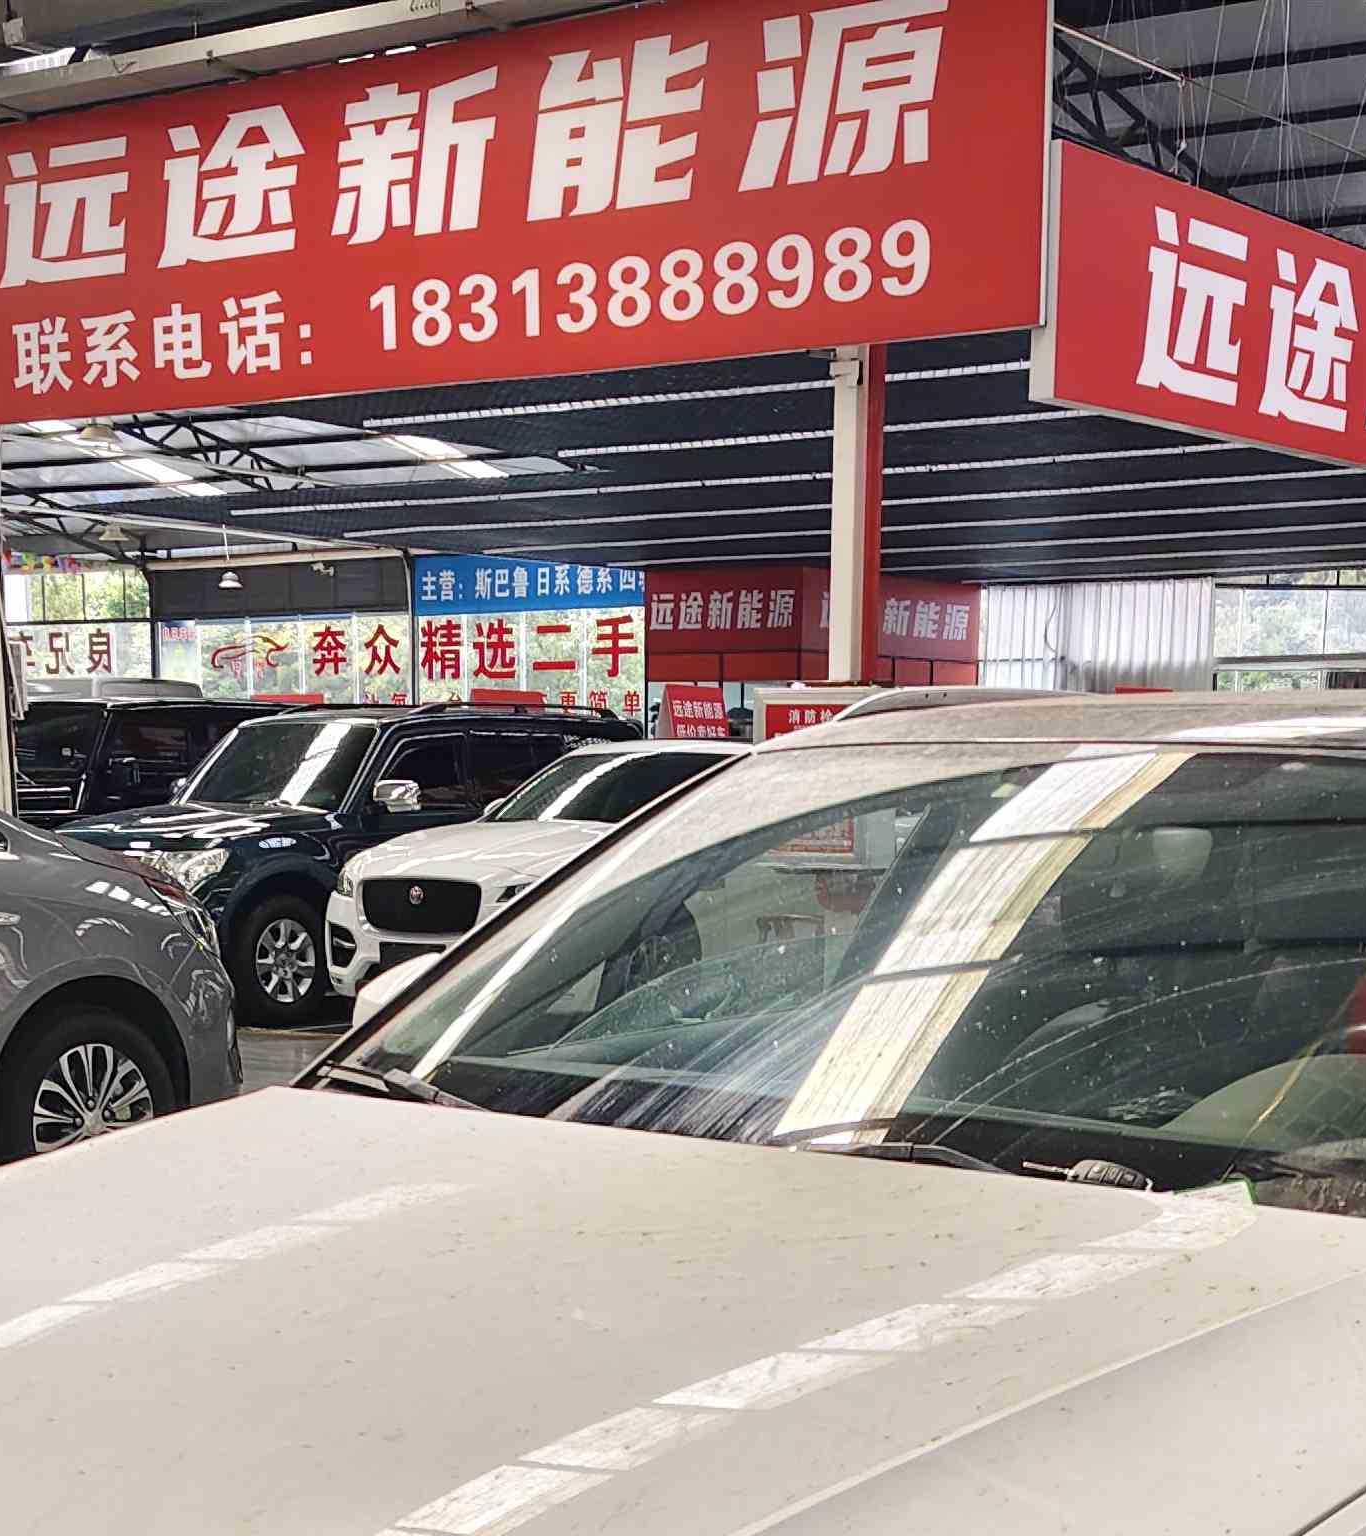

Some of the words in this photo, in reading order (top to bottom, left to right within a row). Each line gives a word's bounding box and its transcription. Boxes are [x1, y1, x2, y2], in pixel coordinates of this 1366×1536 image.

[0, 0, 950, 289] 远途新能源
[649, 589, 796, 631] 远途新能源
